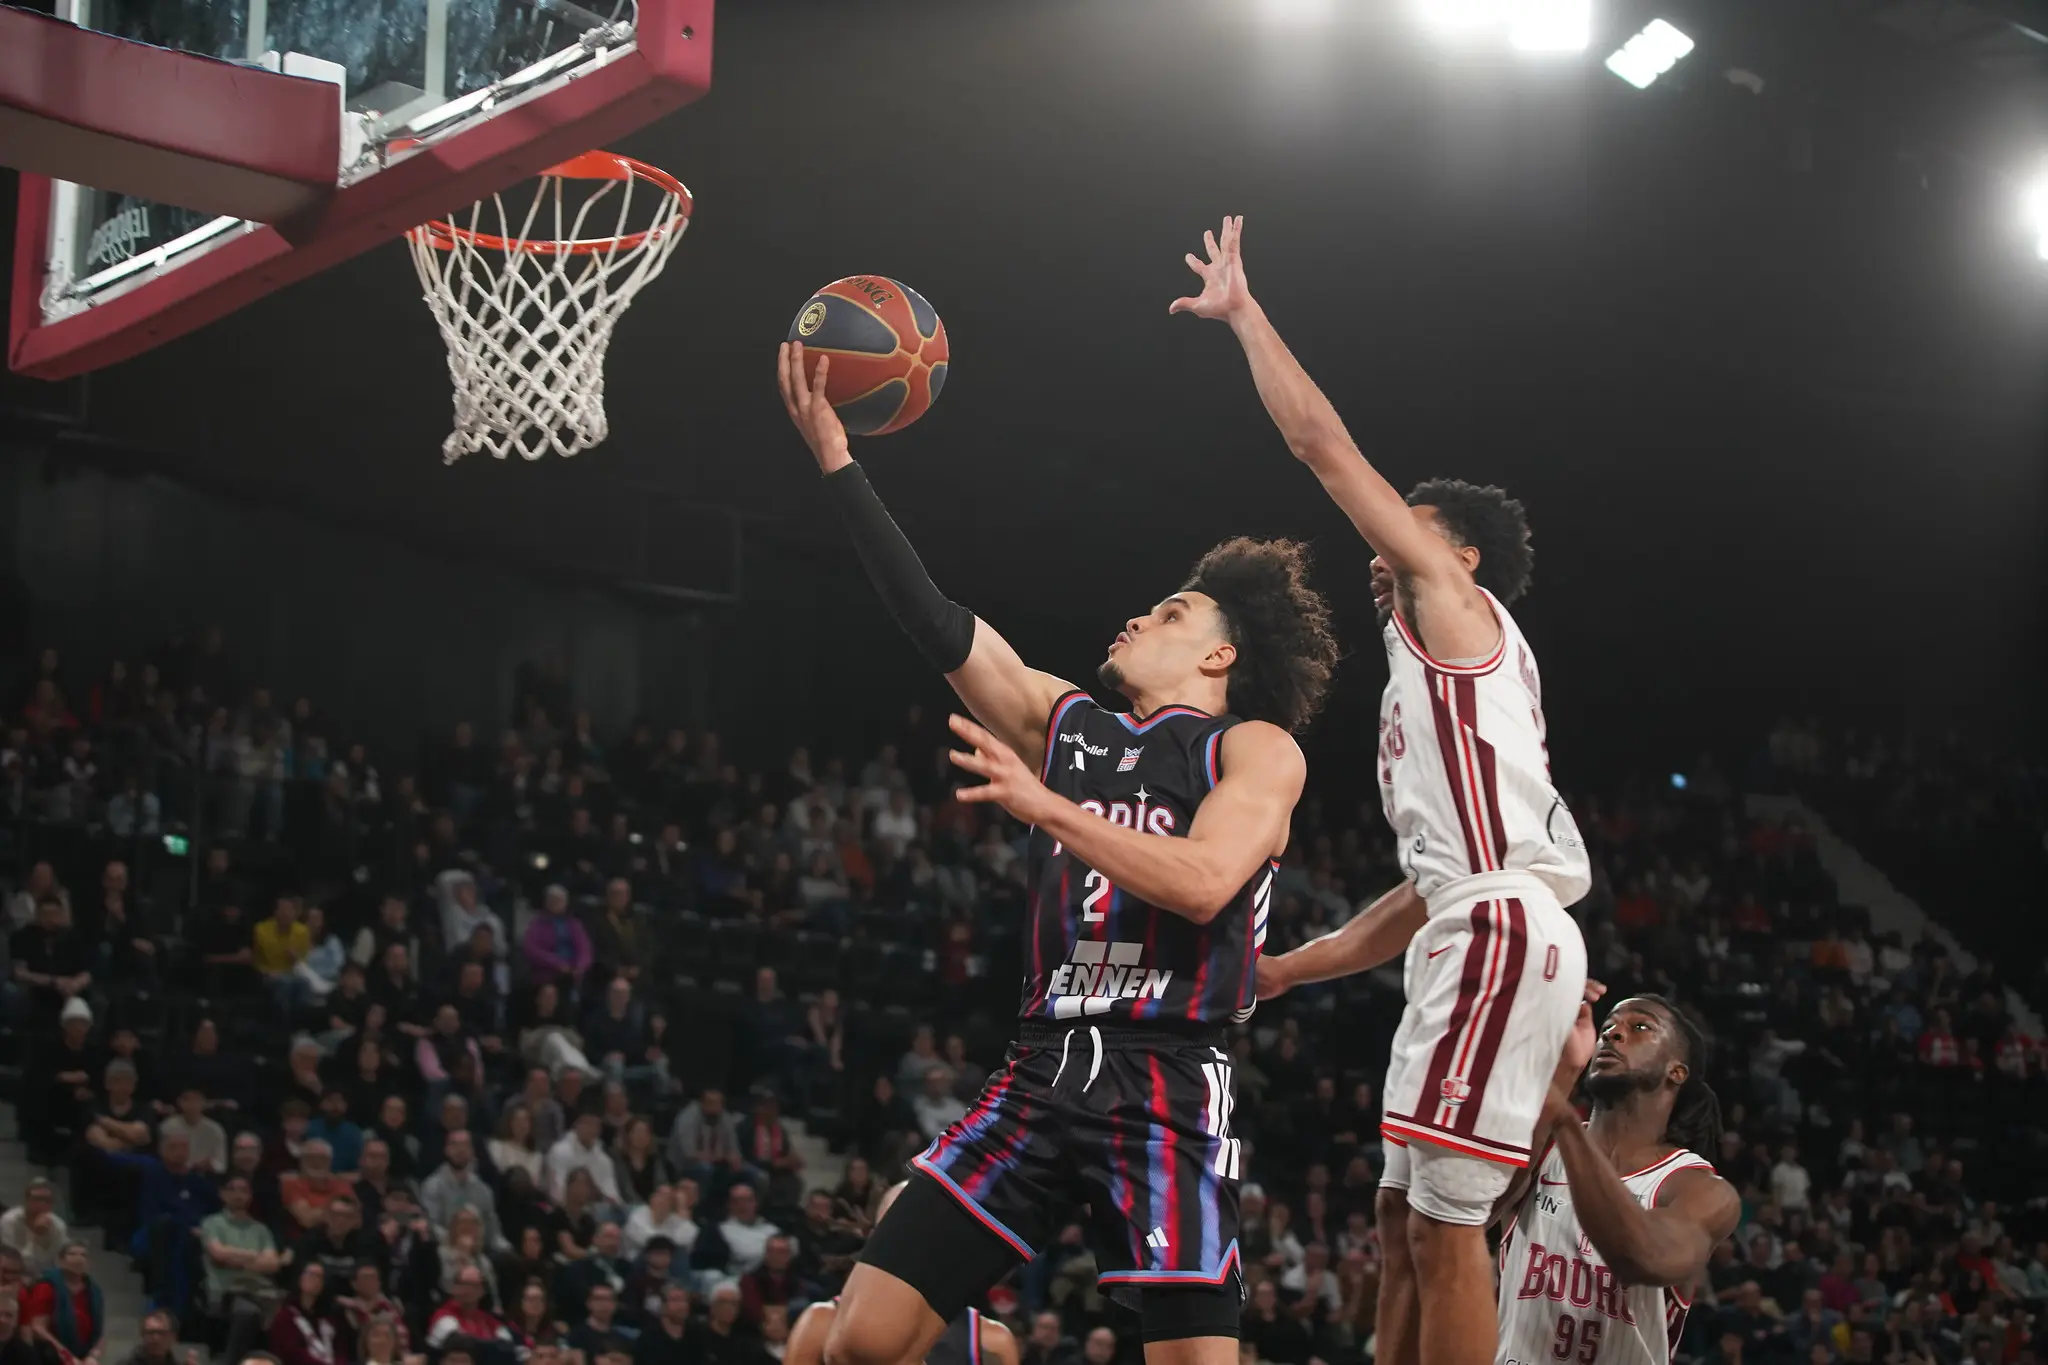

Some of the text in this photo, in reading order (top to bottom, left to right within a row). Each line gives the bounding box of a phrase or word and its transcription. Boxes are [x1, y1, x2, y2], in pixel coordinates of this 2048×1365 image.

[1082, 868, 1110, 922] 2
[1045, 964, 1174, 1000] ENNEN
[1552, 1313, 1602, 1365] 95
